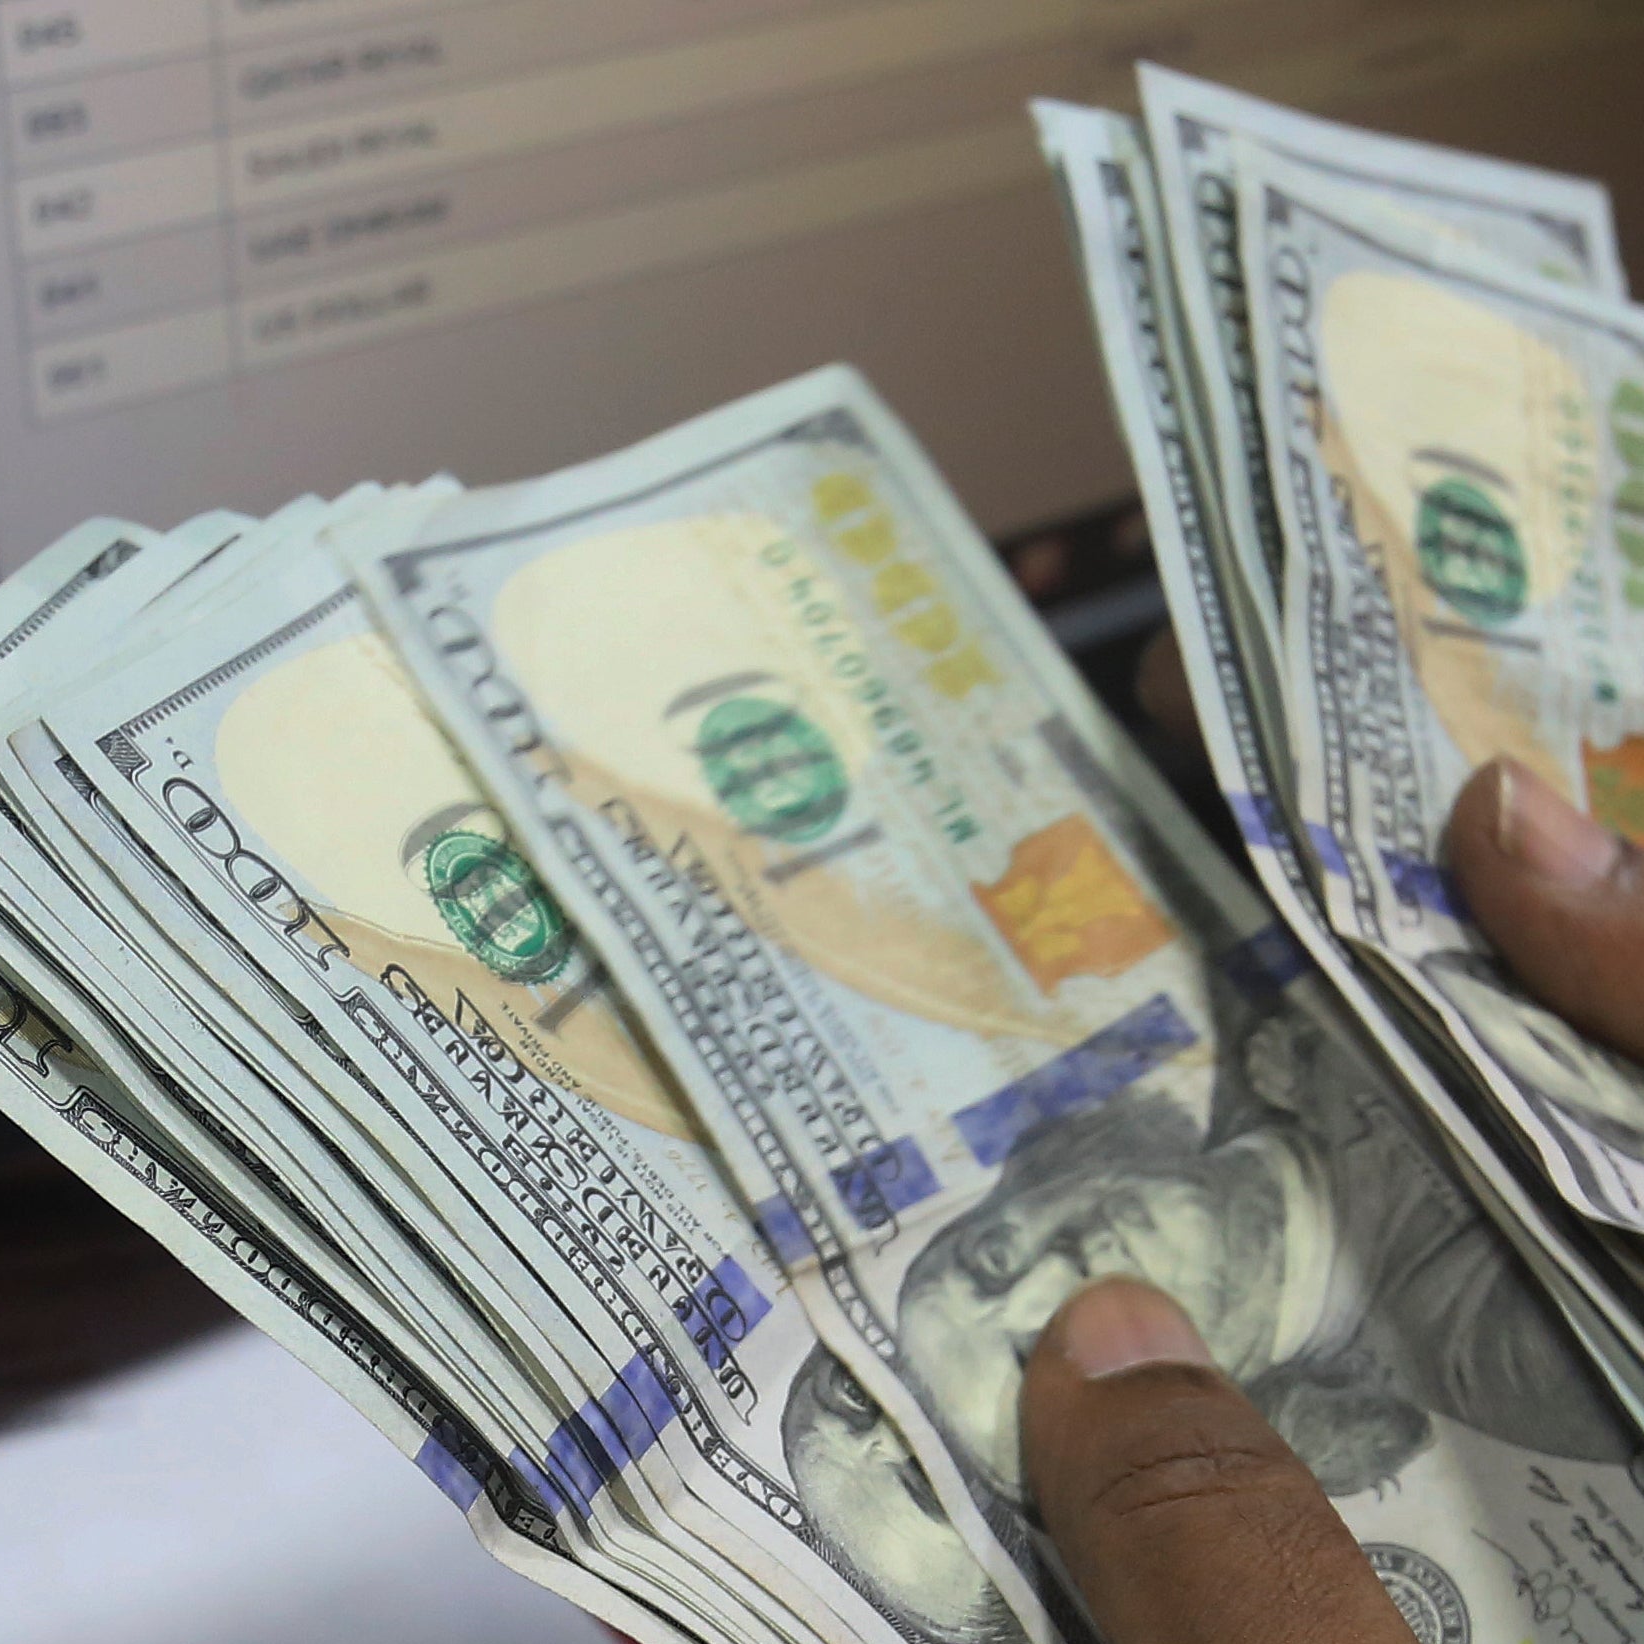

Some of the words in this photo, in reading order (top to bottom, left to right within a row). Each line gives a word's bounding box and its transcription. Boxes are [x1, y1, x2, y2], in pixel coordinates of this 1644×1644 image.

[150, 768, 353, 978] 100
[347, 1002, 549, 1223] DOLLARS
[375, 960, 591, 1195] STATES
[452, 987, 691, 1252] AMERICA
[72, 1103, 309, 1309] DOLLARS
[499, 1133, 630, 1276] THE
[575, 1183, 762, 1426] UNITED
